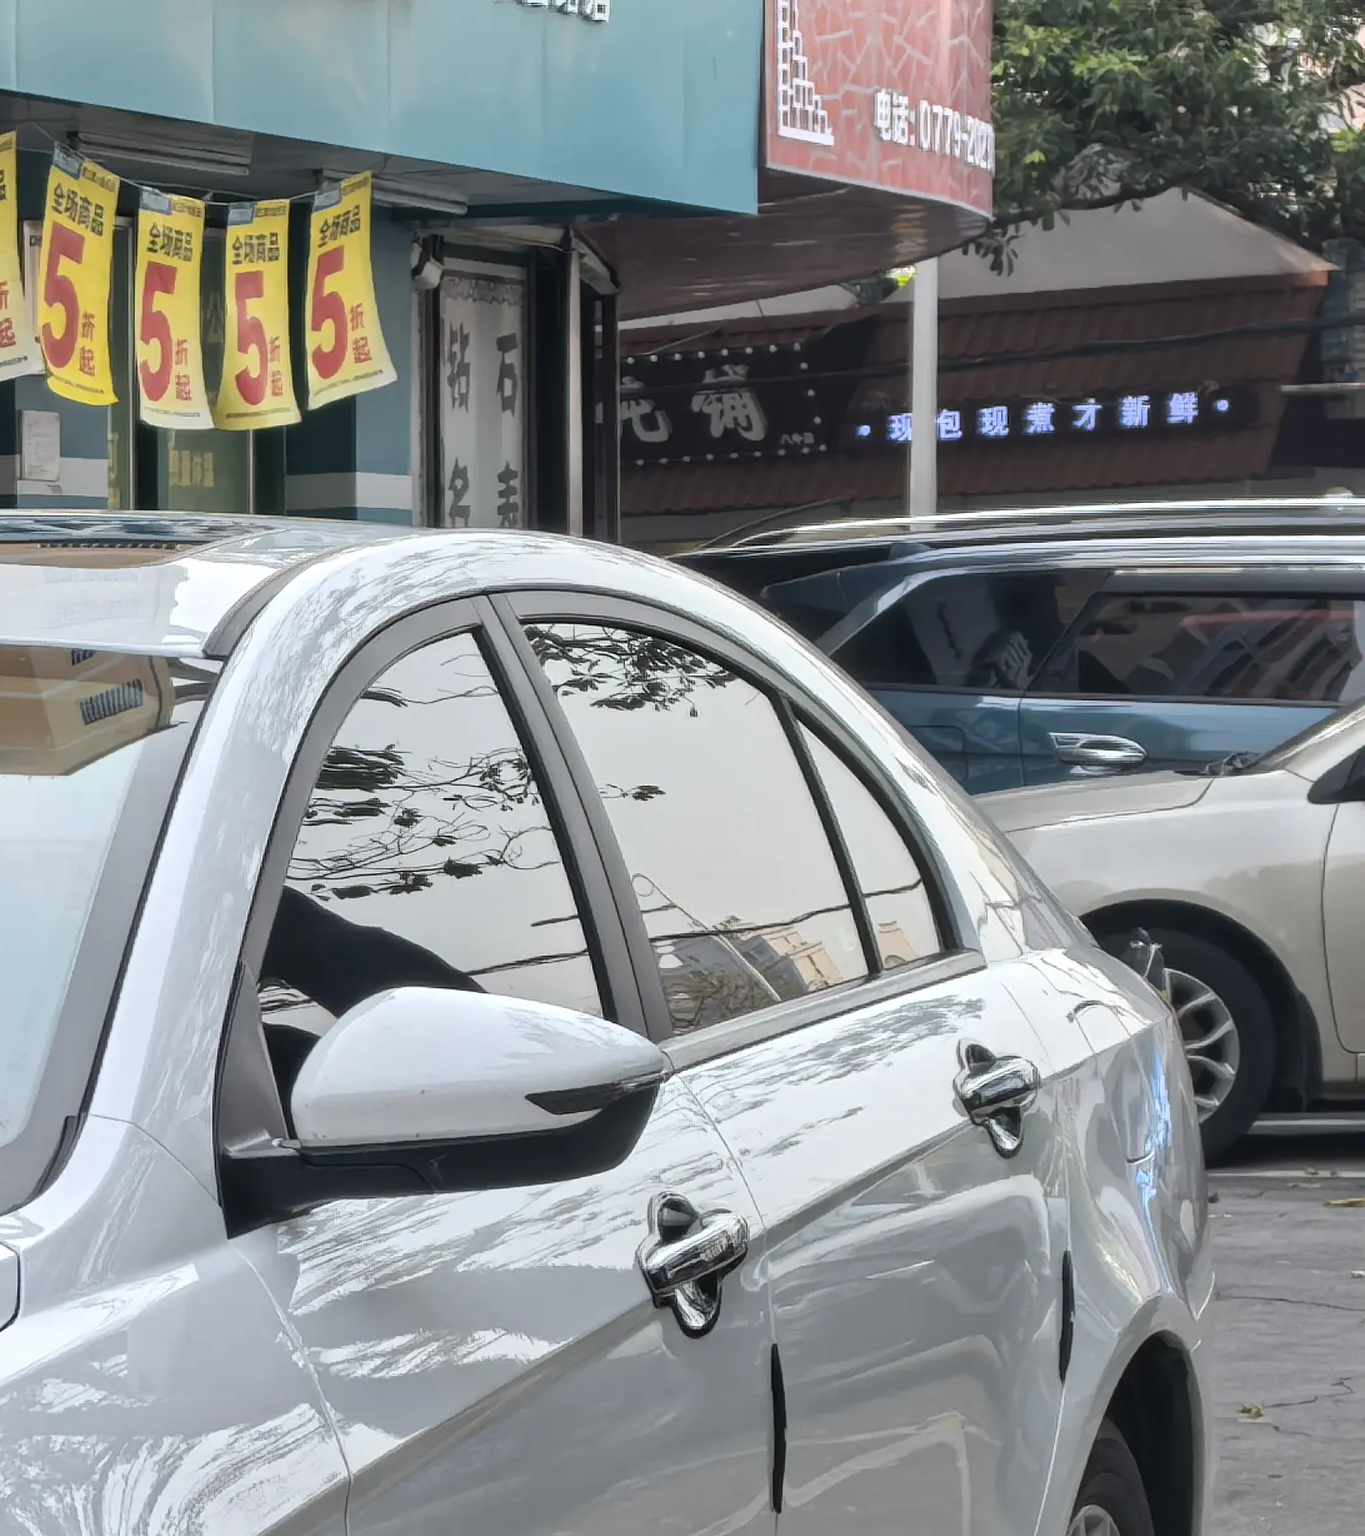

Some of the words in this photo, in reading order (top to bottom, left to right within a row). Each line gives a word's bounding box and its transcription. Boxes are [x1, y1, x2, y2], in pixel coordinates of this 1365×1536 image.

[40, 221, 86, 369] 5
[78, 310, 96, 377] 折起
[140, 260, 178, 402] 5
[174, 338, 192, 401] 折起
[234, 269, 269, 405] 5
[268, 337, 284, 398] 折起
[310, 247, 349, 381] 5
[349, 302, 373, 365] 折起
[886, 391, 1199, 443] 现包现煮才新鲜
